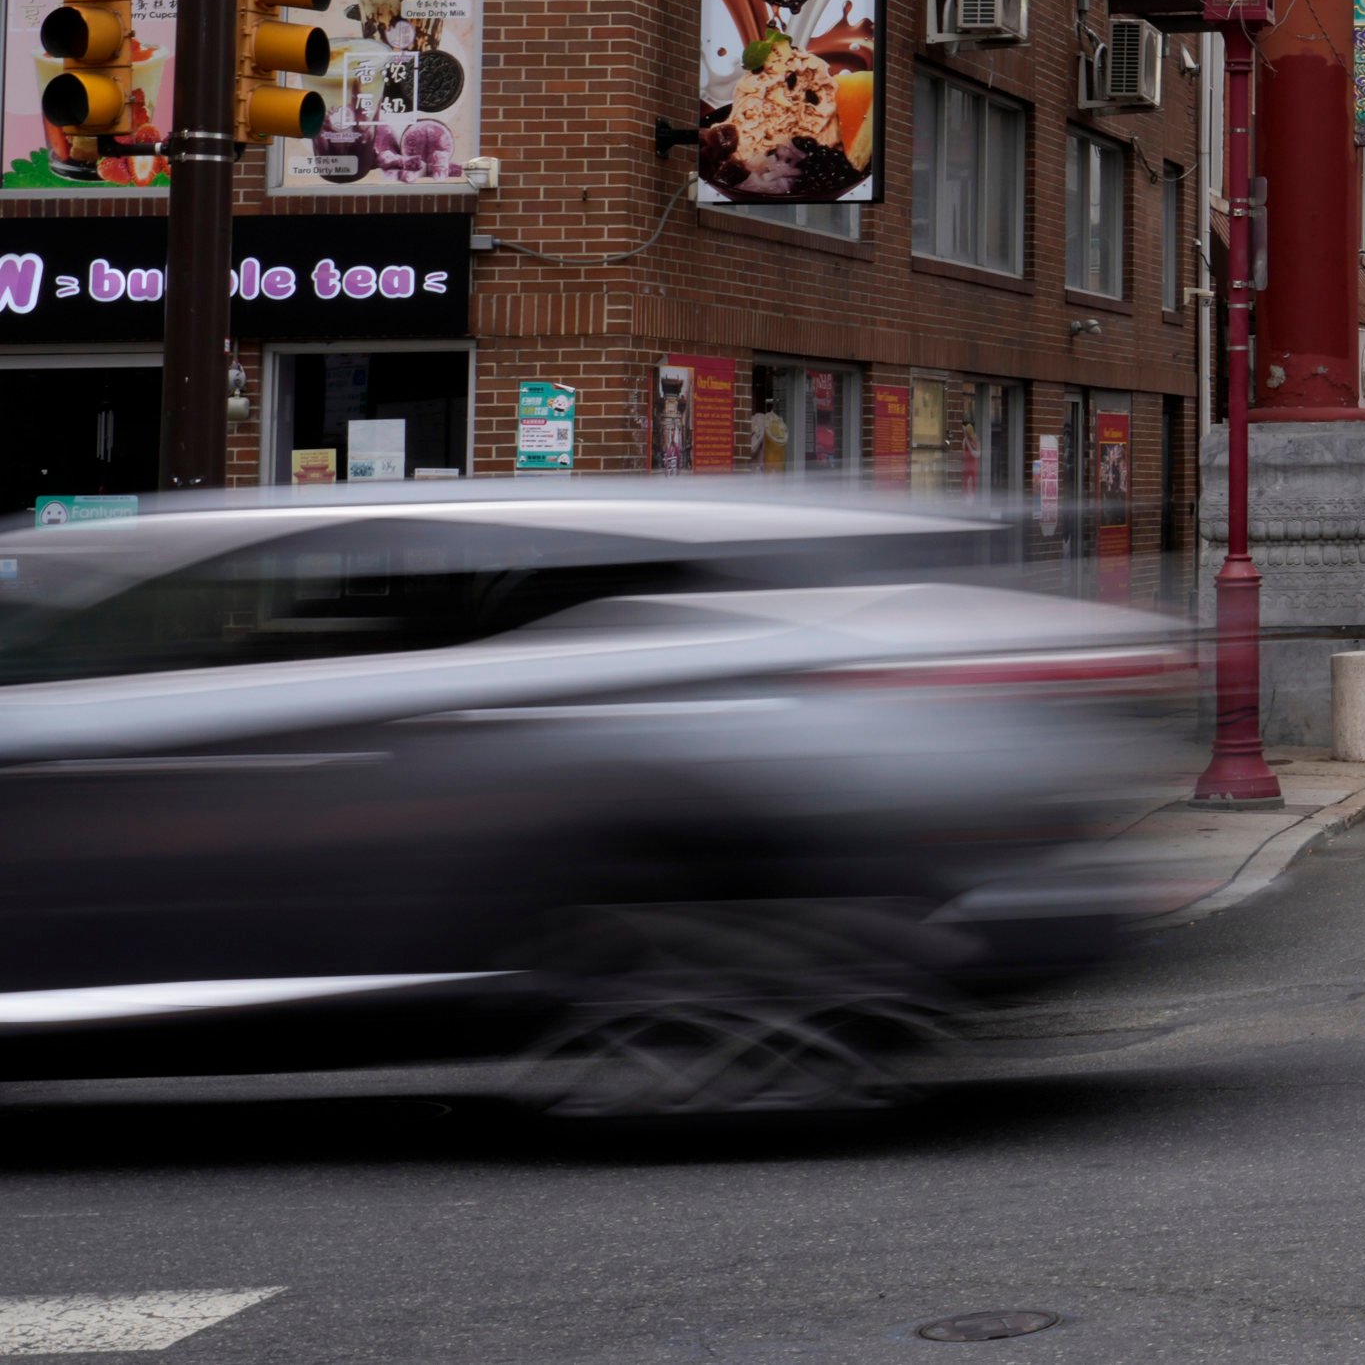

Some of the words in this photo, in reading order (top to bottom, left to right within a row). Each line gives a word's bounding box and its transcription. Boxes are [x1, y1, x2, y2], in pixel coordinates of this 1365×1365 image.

[406, 10, 427, 18] Oreo
[427, 10, 449, 19] Dirty
[450, 9, 466, 18] Milk
[293, 167, 312, 175] Taro
[313, 167, 333, 176] Dirty
[334, 167, 351, 175] Milk
[89, 257, 297, 303] bule
[311, 257, 416, 300] tea
